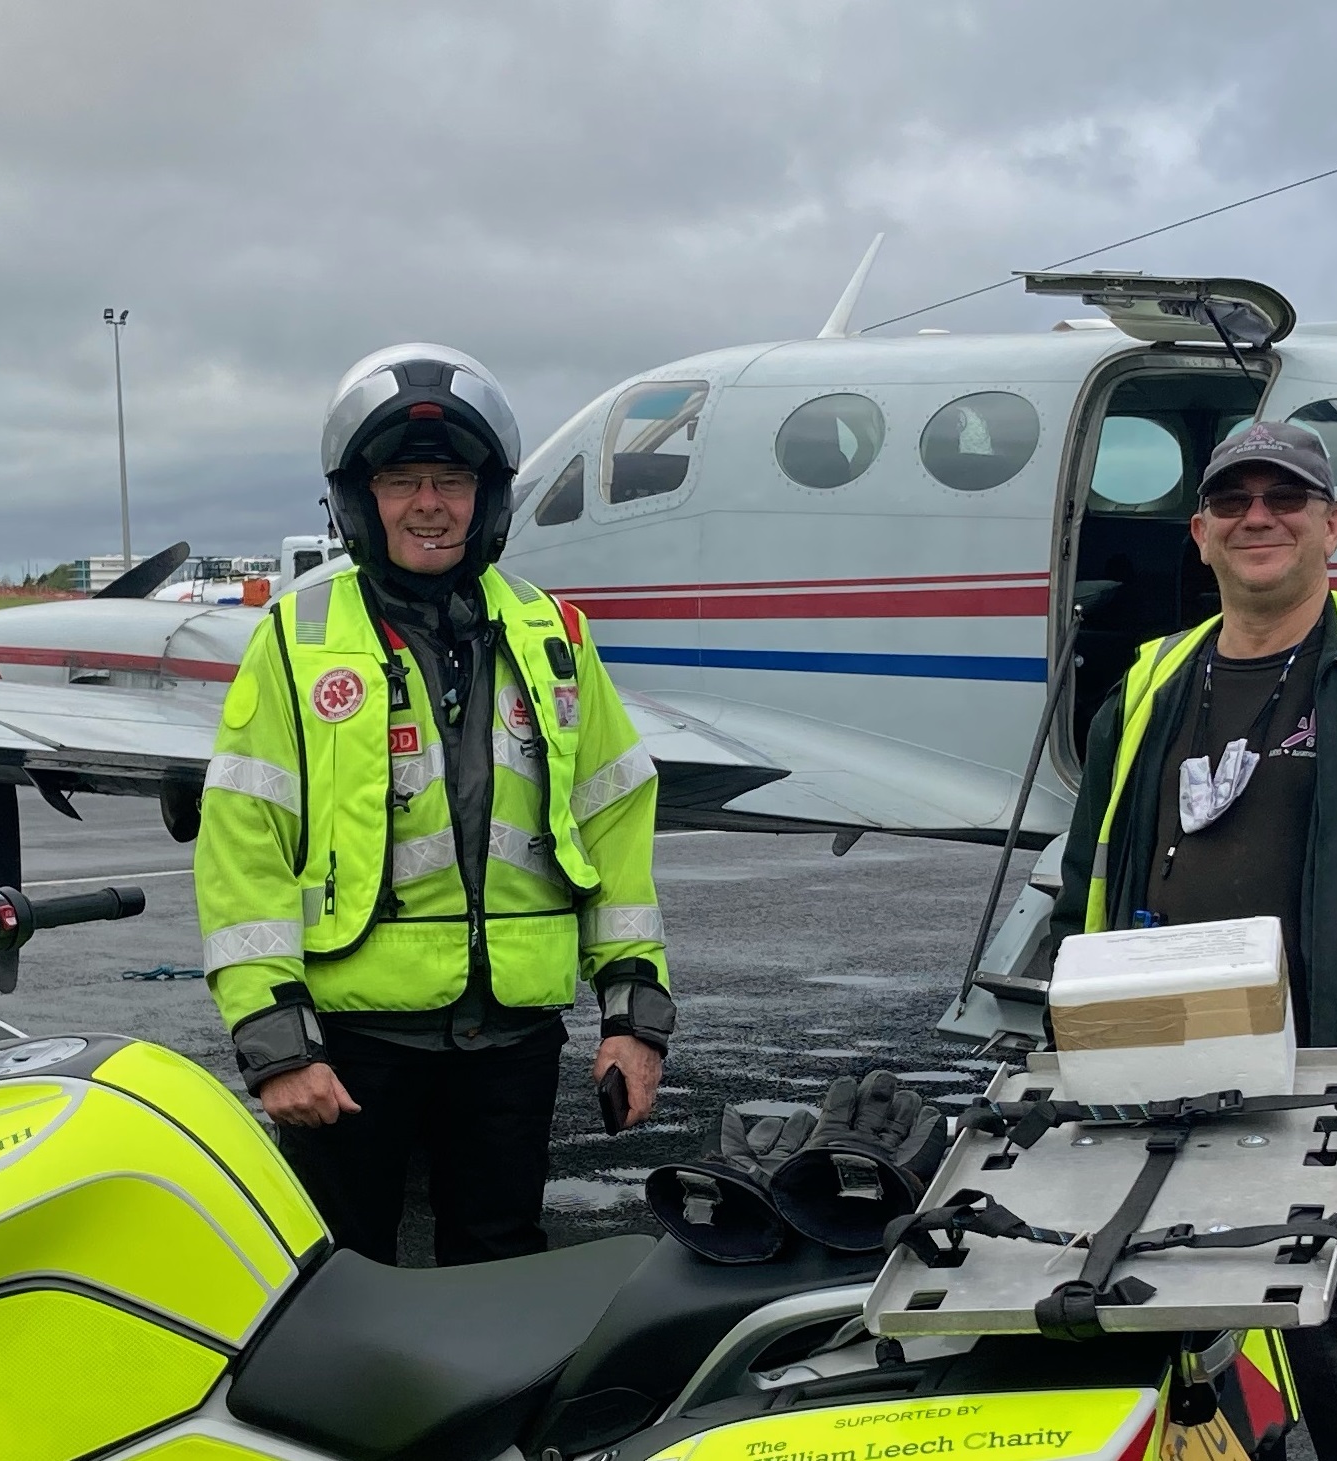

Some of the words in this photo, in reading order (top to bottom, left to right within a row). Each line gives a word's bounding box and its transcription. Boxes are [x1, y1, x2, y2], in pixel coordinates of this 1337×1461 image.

[834, 1407, 952, 1429] SUPPORTED
[957, 1405, 983, 1416] BY
[746, 1440, 787, 1456] The
[864, 1435, 954, 1460] Leech
[963, 1427, 1072, 1449] Charity
